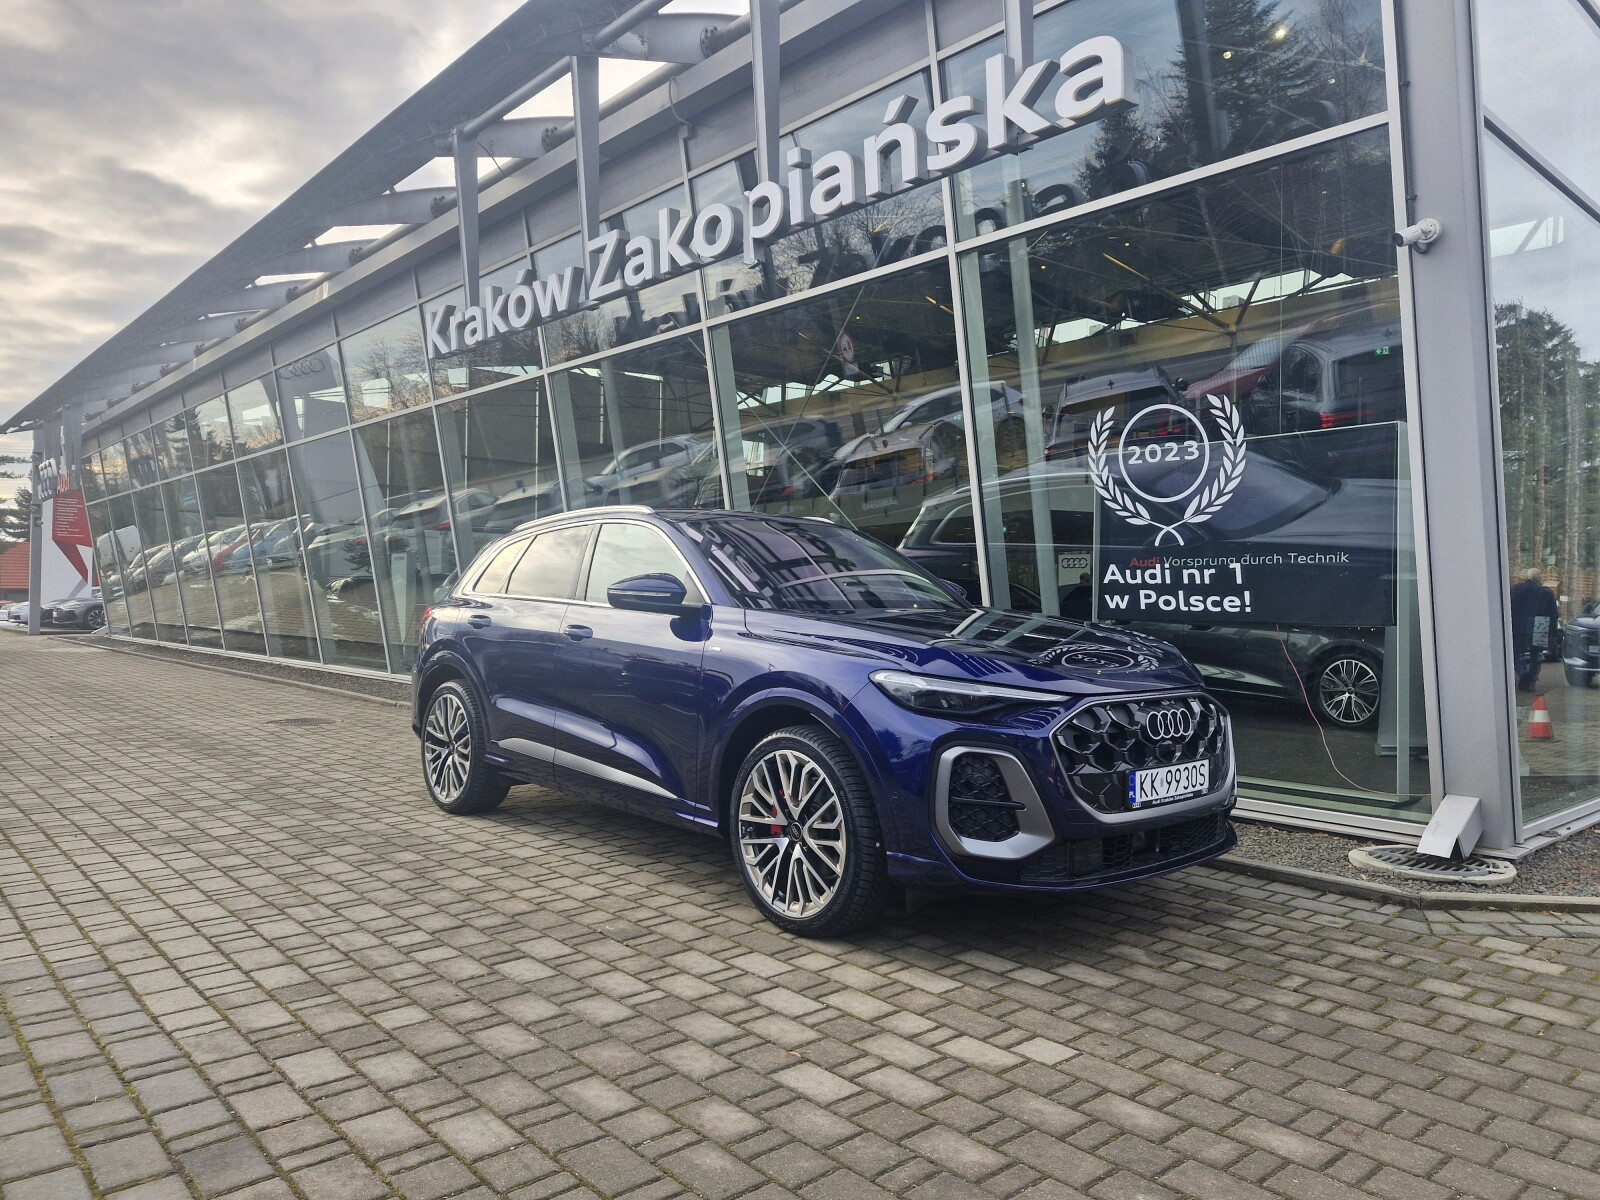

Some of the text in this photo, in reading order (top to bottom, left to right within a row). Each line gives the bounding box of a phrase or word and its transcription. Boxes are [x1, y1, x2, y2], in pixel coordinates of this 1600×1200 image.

[426, 35, 1130, 359] Kraków Zakopiańska
[1128, 440, 1199, 465] 2023
[1129, 551, 1350, 568] Audi Vorsprung durch Technik
[1103, 562, 1242, 585] Audi nr 1
[1104, 589, 1252, 613] w Polsce!
[1140, 763, 1206, 799] KK 9930S
